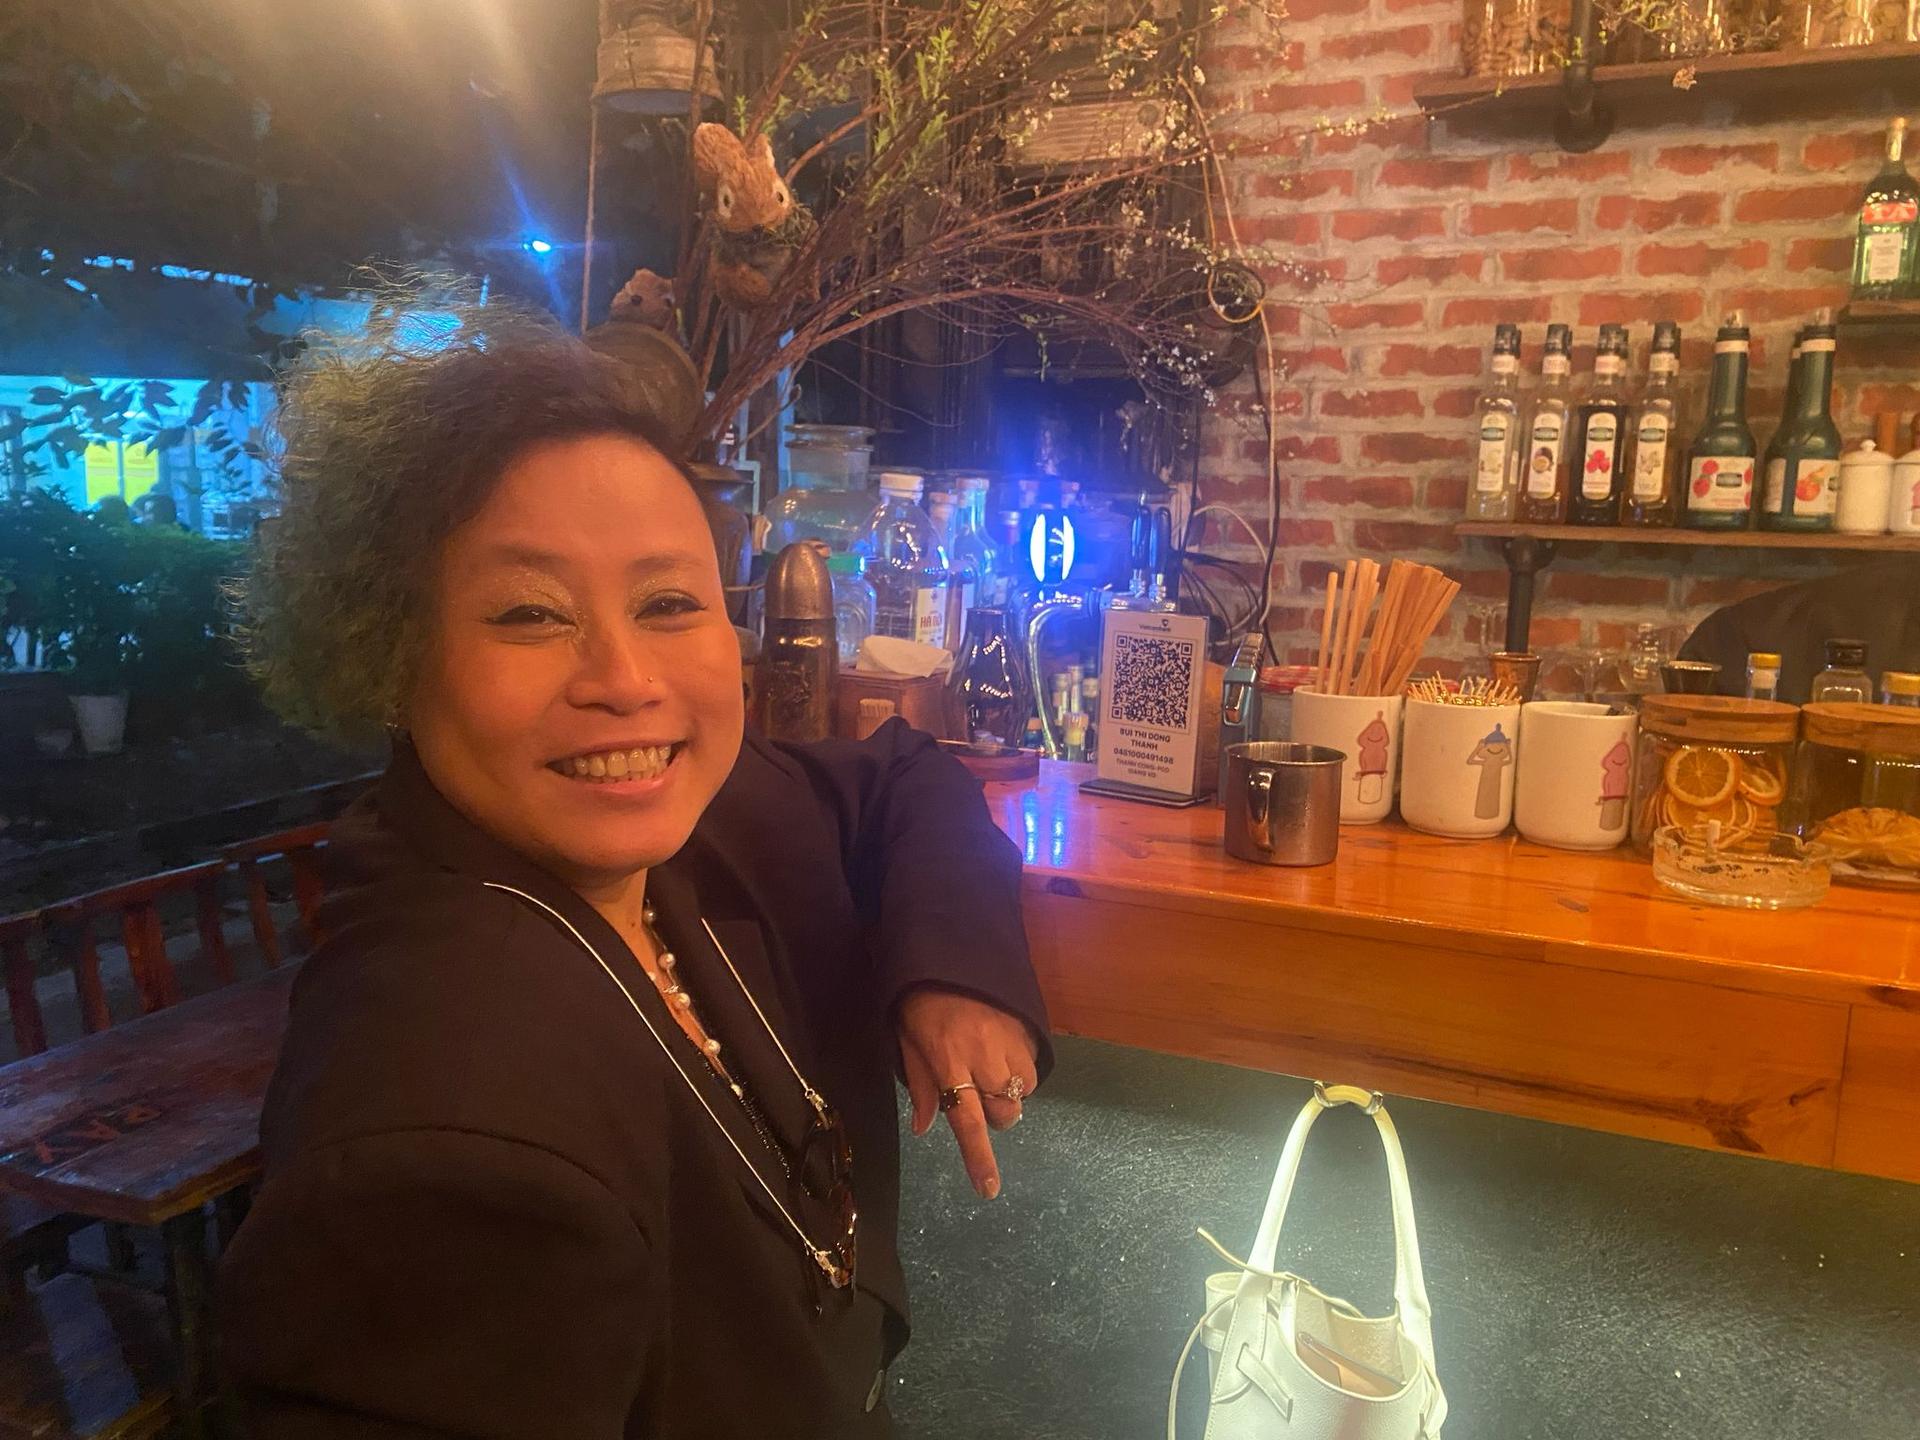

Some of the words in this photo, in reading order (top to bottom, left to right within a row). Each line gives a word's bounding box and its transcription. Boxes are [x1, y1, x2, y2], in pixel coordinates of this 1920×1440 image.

[1120, 728, 1133, 736] BUI
[1134, 730, 1147, 738] THI
[1148, 733, 1171, 743] DONG
[1131, 739, 1158, 750] THANH
